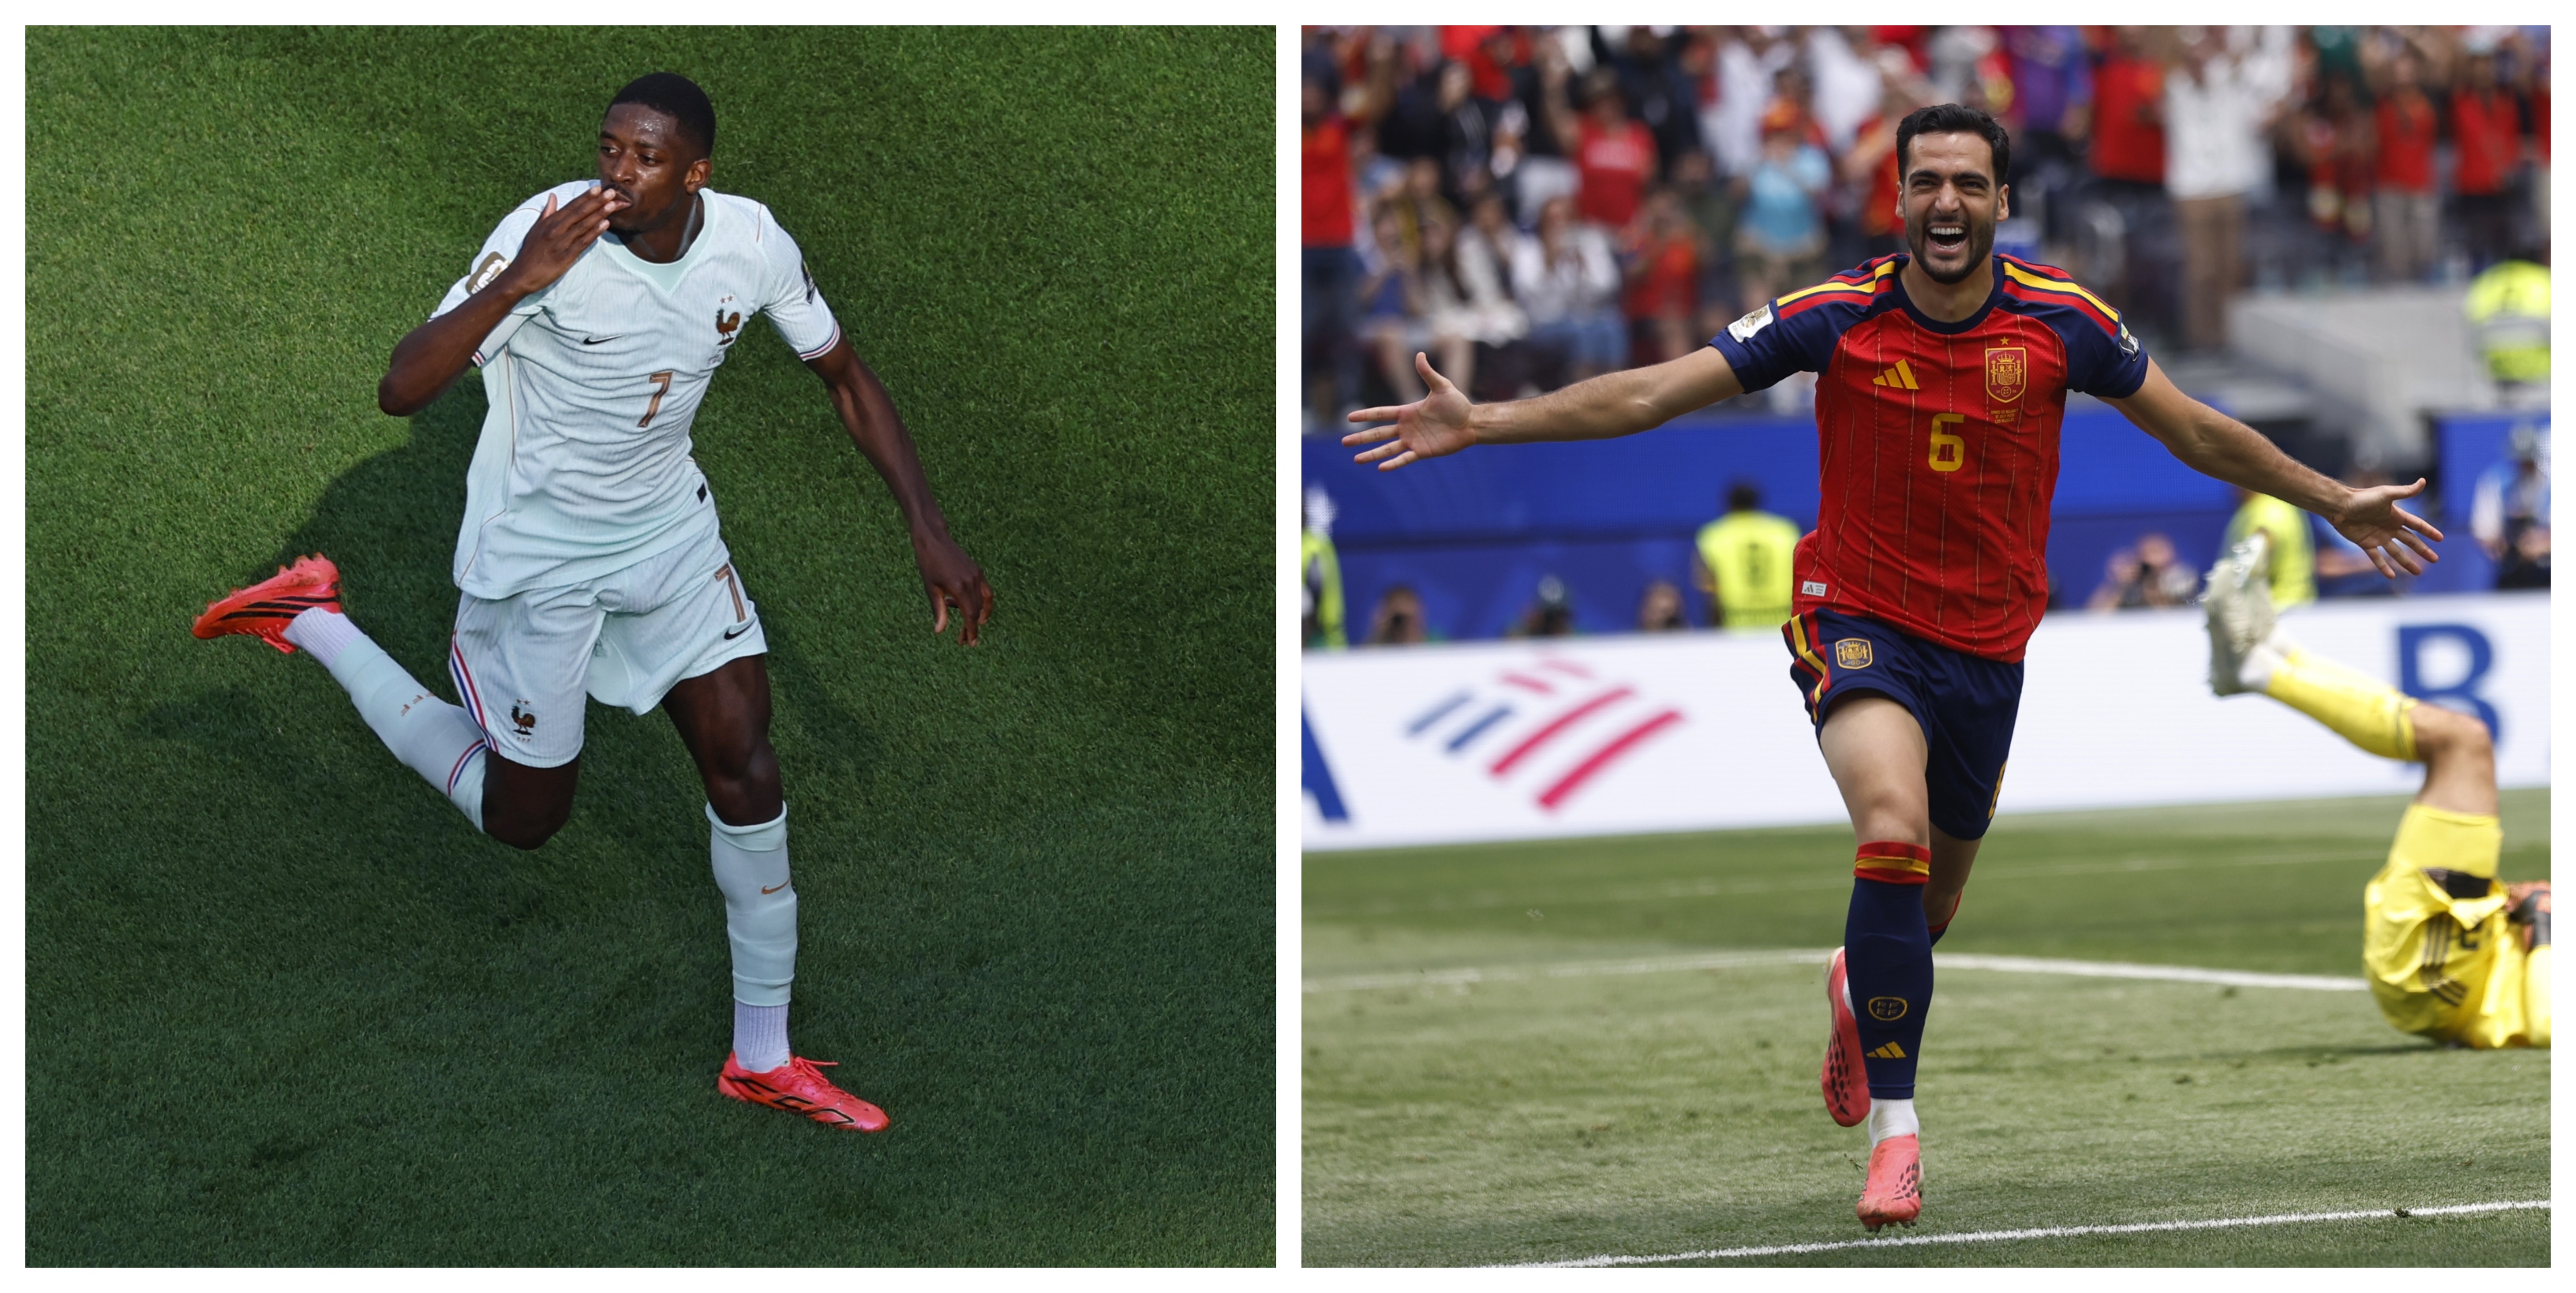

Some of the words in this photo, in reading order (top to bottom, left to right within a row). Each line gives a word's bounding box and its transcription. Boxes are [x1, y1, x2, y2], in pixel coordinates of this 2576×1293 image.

[637, 371, 673, 428] 7
[1928, 413, 1965, 472] 6
[713, 563, 747, 623] 7
